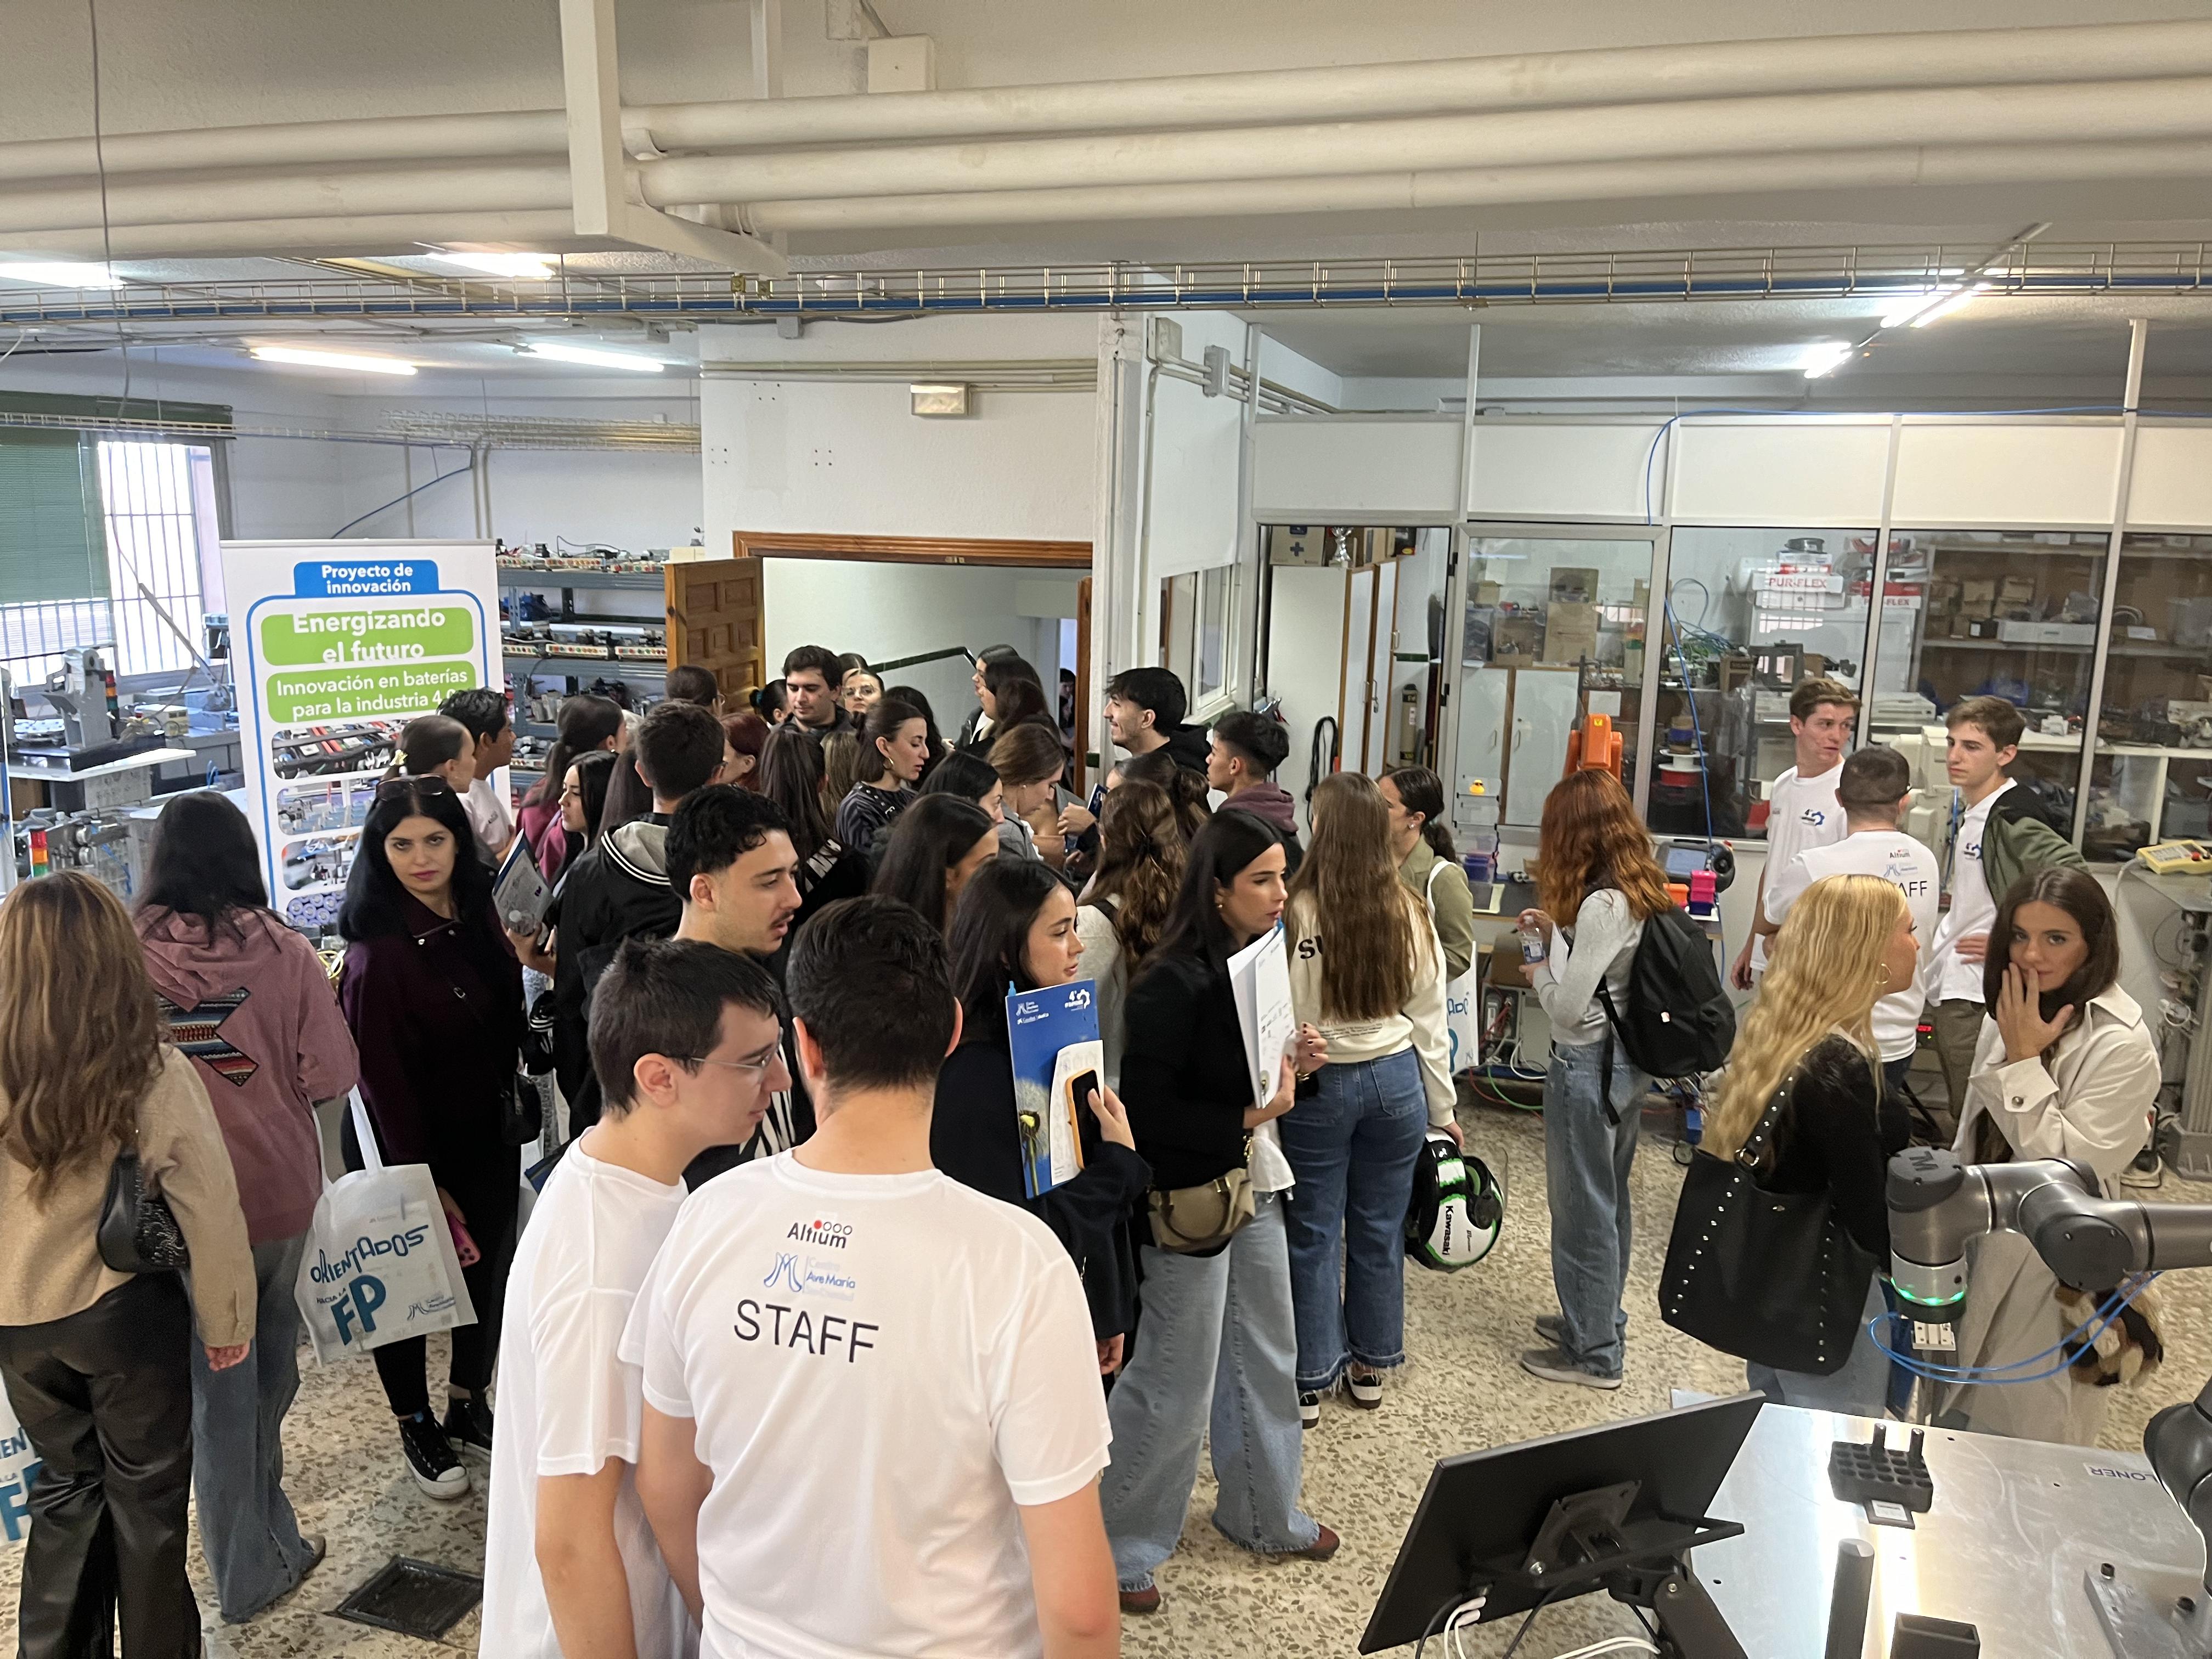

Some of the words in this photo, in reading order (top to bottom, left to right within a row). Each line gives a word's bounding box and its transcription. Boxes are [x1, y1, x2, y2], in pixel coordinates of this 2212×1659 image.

[322, 563, 389, 582] Proyecto
[394, 563, 413, 578] de
[327, 578, 411, 594] innovación
[294, 608, 445, 636] Energizando
[323, 641, 345, 663] el
[350, 640, 424, 662] futuro
[278, 675, 374, 696] Innovación
[379, 676, 399, 688] en
[403, 668, 468, 686] baterías
[292, 699, 331, 721] para
[336, 697, 352, 713] la
[357, 692, 428, 712] industria
[1895, 881, 1927, 897] AFF
[787, 1222, 847, 1249] Altium
[1442, 1205, 1454, 1255] Kawasaki
[825, 1274, 856, 1289] María
[331, 1274, 386, 1346] FP
[733, 1299, 879, 1363] STAFF
